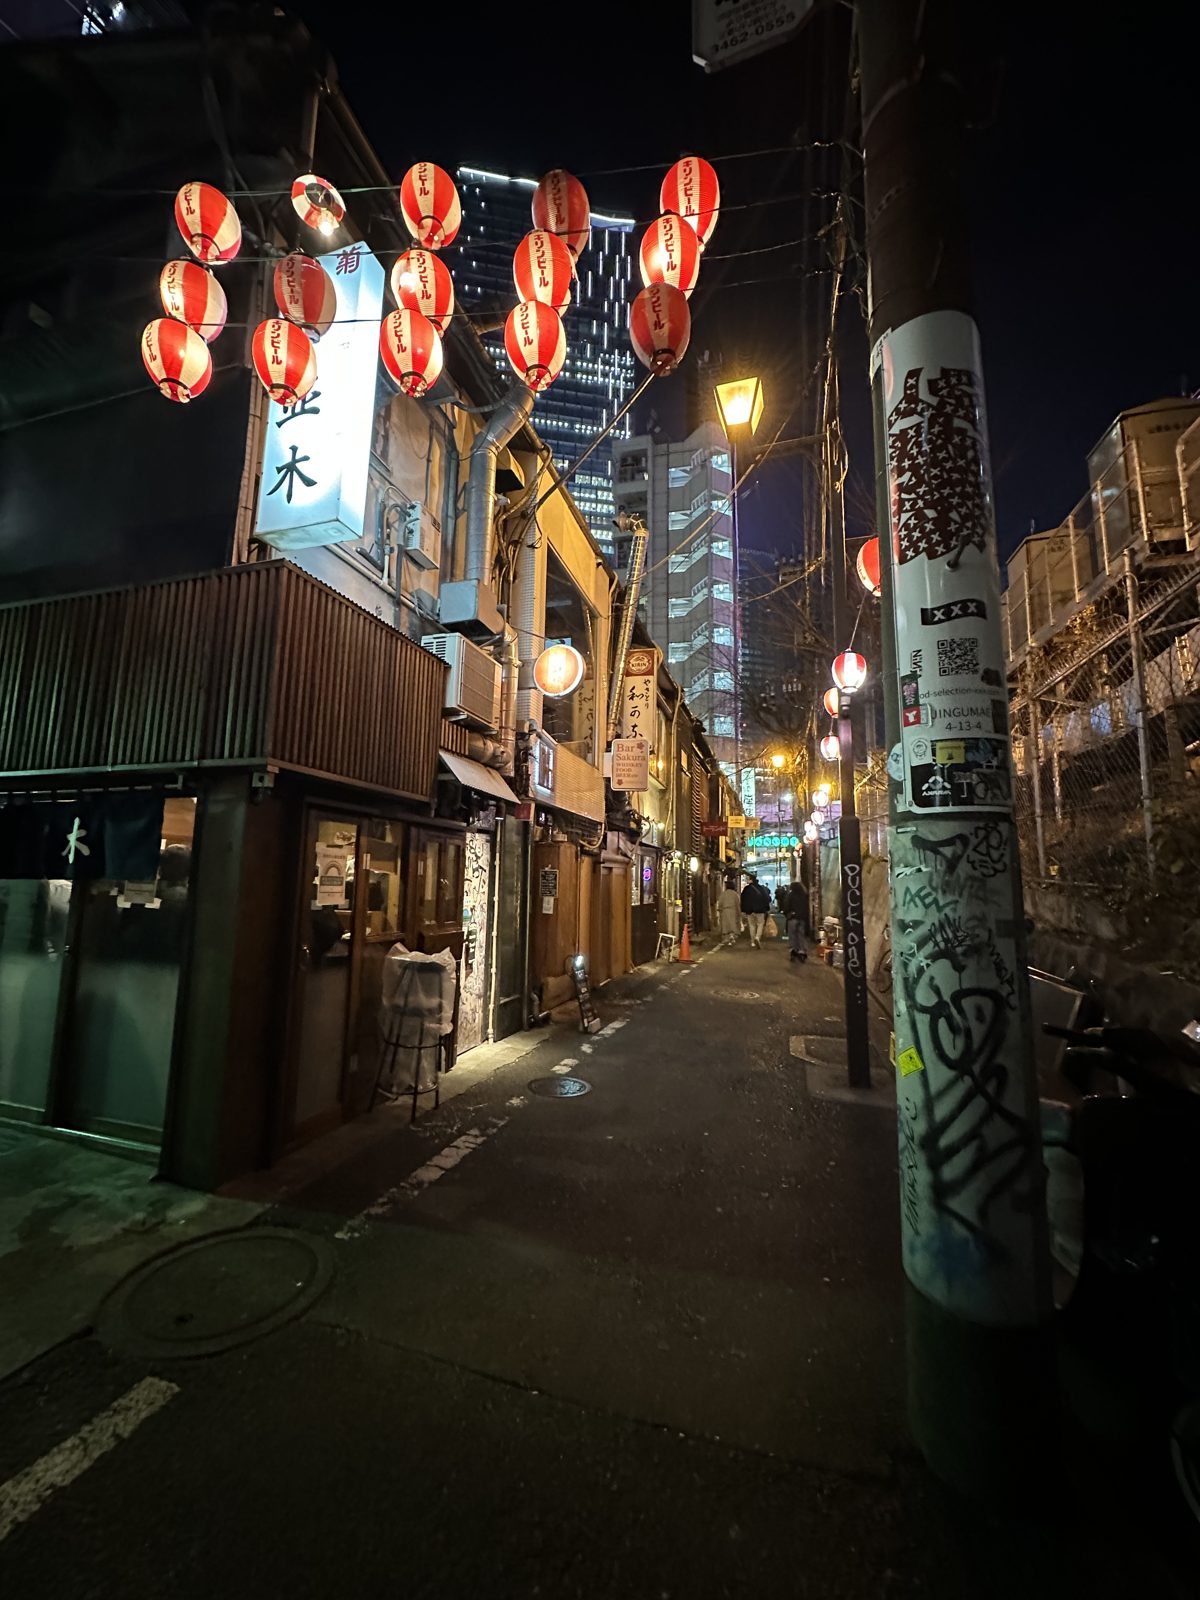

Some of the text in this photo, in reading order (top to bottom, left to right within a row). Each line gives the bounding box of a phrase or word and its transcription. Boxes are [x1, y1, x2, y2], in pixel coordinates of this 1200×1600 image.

[336, 245, 363, 276] 菊
[533, 234, 550, 289] キリンビール
[663, 217, 677, 272] キリンビール
[416, 251, 432, 300] キリンビール
[945, 721, 982, 731] 4-13-4
[616, 744, 636, 752] Bar
[616, 753, 646, 762] Sakura
[61, 816, 91, 865] 木
